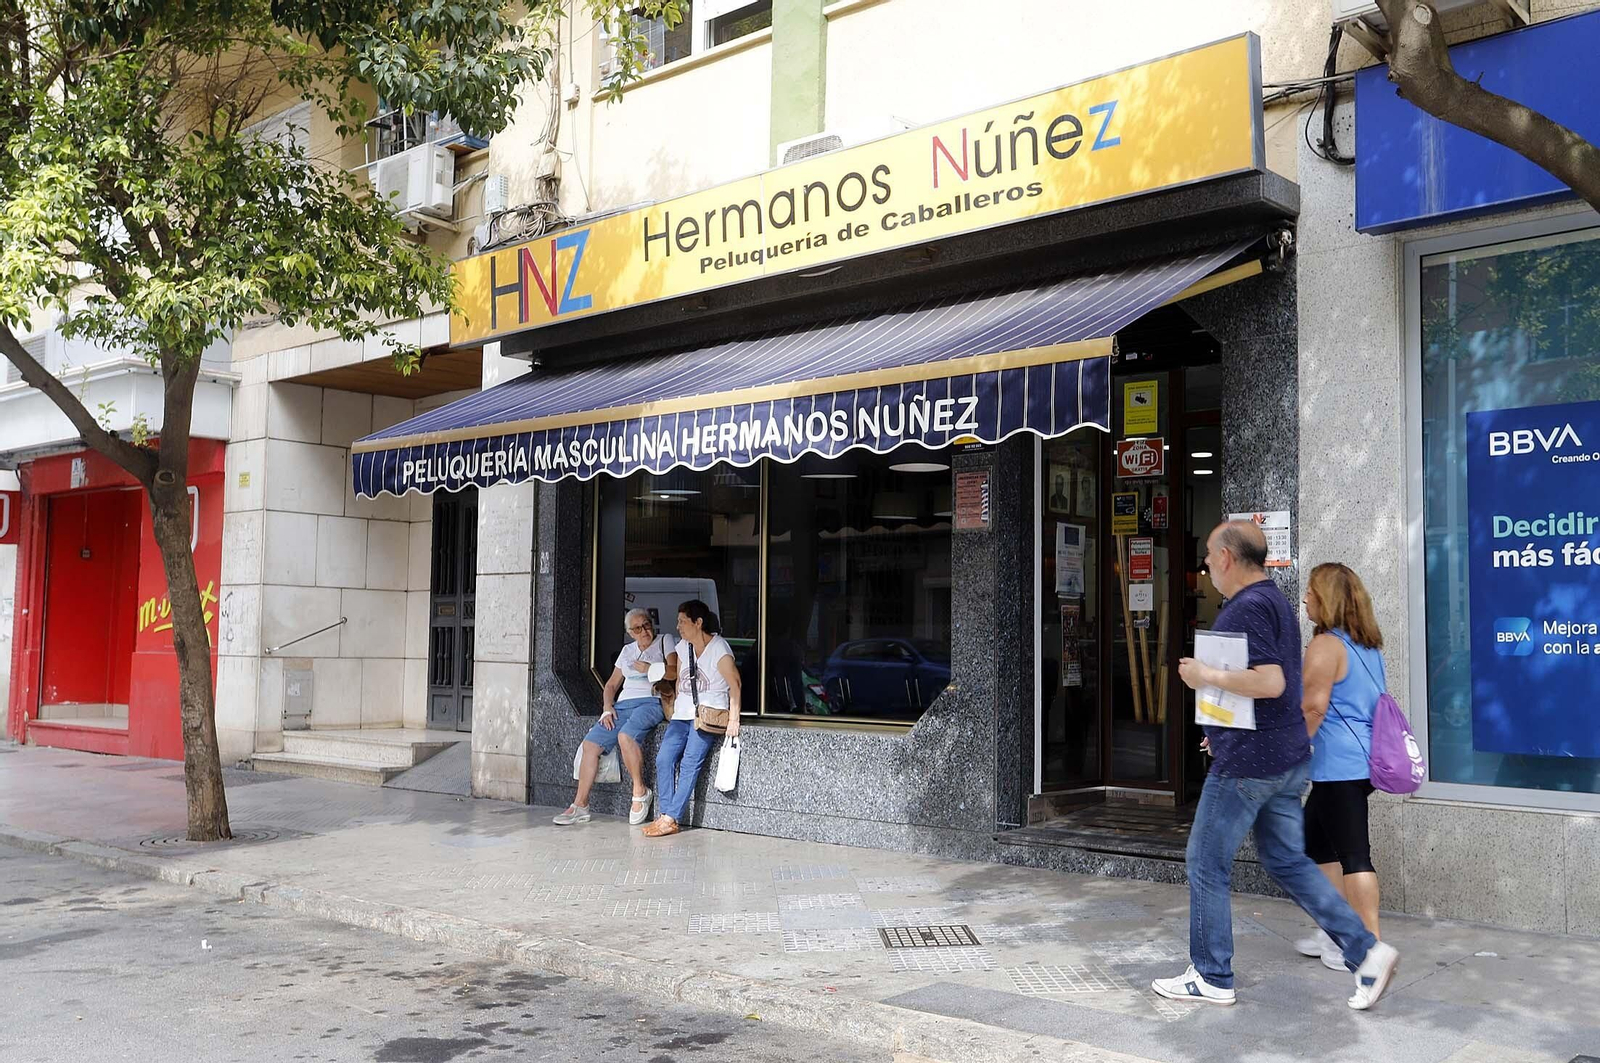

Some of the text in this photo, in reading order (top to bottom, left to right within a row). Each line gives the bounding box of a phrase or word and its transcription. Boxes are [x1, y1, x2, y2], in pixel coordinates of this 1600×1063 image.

[644, 100, 1121, 262] Hermanos Núñez
[700, 182, 1043, 274] Peluquería de Caballeros
[490, 229, 592, 330] HNZ
[402, 394, 979, 485] PELUQUERÍA MASCULINA HERMANOS NUÑEZ
[1489, 423, 1582, 456] BBVA
[1552, 453, 1591, 464] Creando
[1492, 511, 1599, 538] Decidir
[1493, 543, 1554, 567] más
[1497, 631, 1531, 642] BBVA
[1543, 620, 1598, 638] Mejora
[1543, 643, 1572, 655] con
[1576, 640, 1590, 655] la
